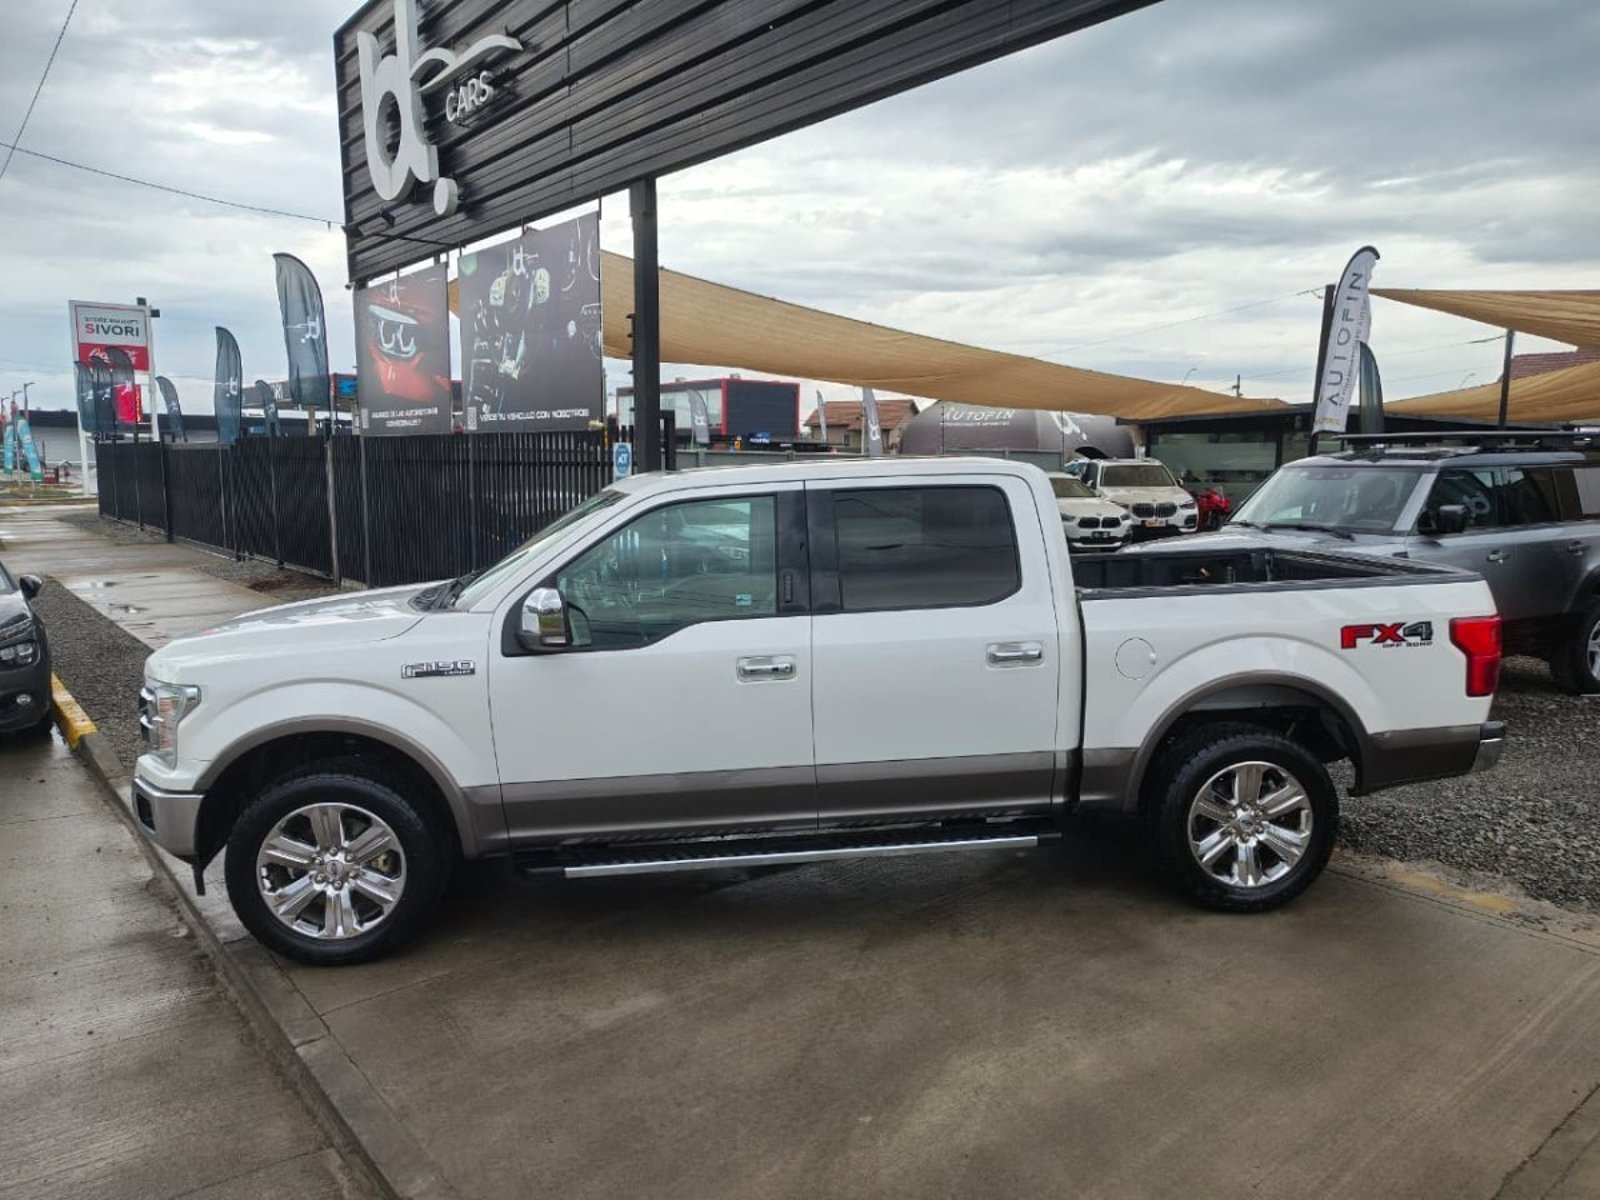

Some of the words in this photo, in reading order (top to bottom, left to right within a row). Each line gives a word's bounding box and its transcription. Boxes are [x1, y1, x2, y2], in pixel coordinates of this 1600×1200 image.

[446, 70, 494, 122] CARS
[85, 323, 139, 337] SIVORI
[1320, 272, 1363, 406] AUTOFIN
[536, 411, 550, 419] CON
[1341, 620, 1433, 650] FX4
